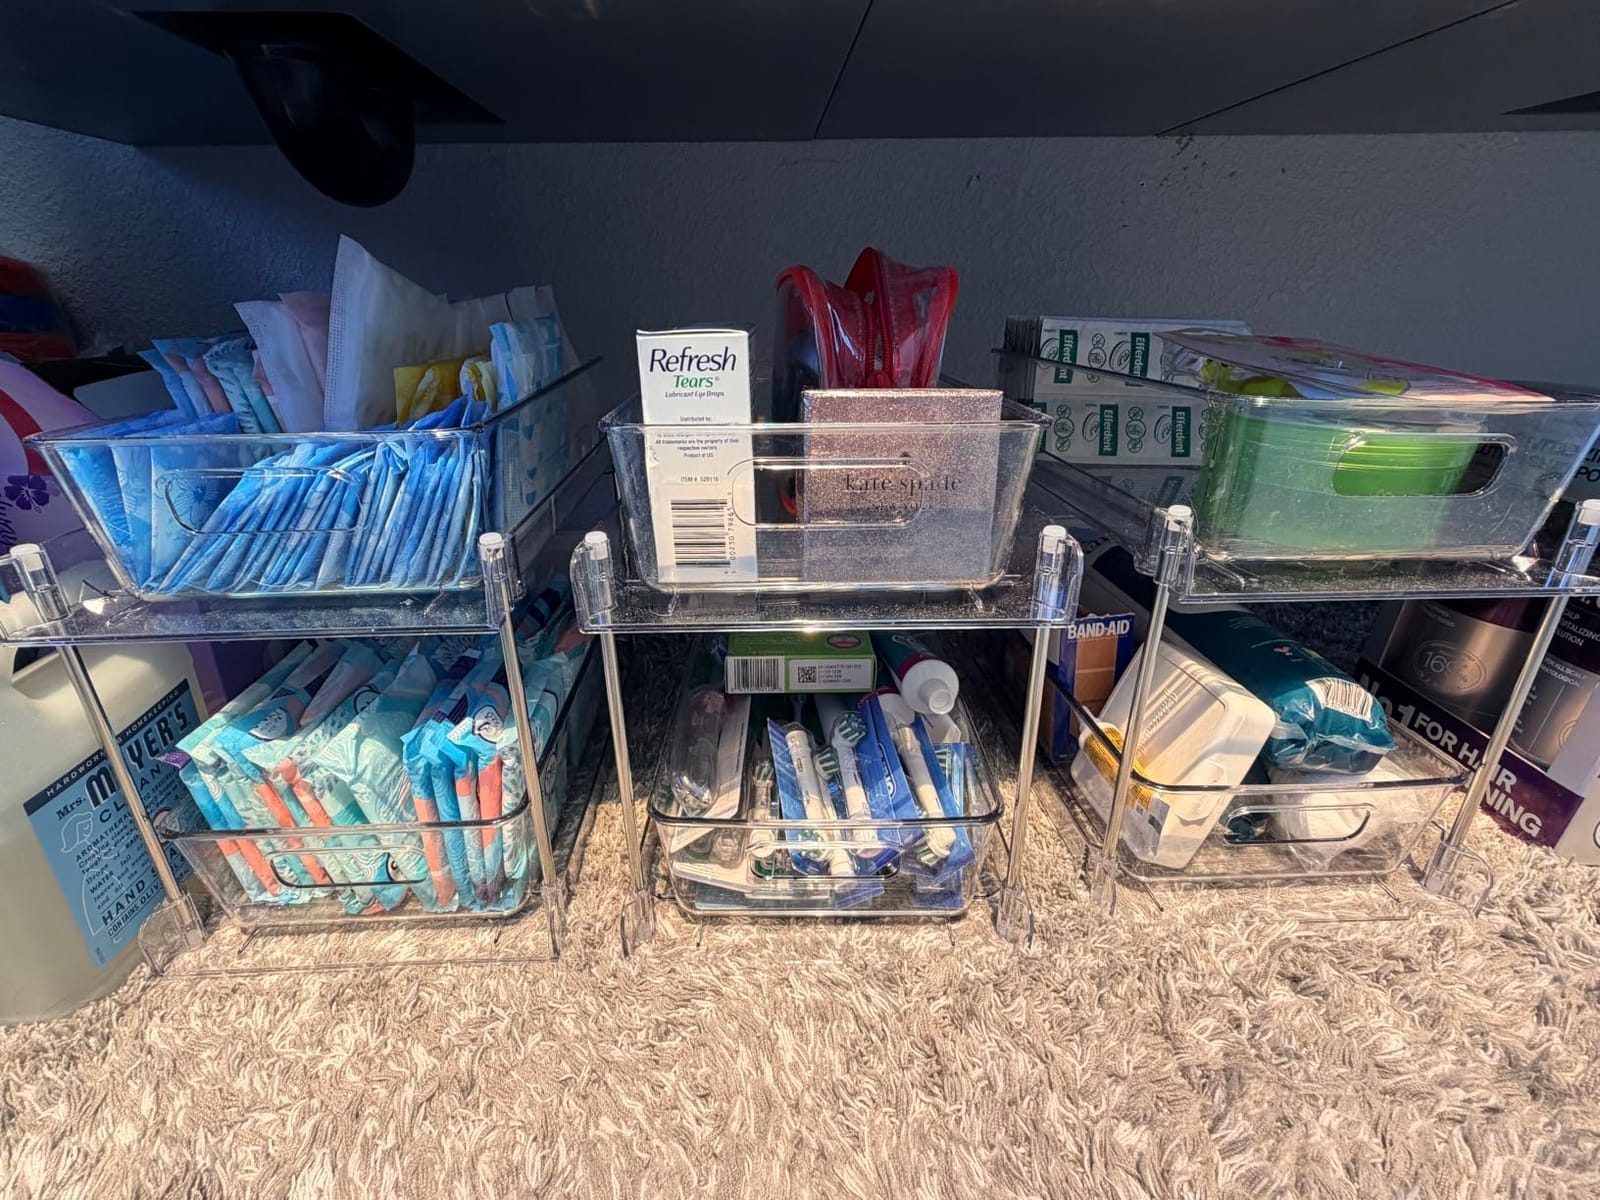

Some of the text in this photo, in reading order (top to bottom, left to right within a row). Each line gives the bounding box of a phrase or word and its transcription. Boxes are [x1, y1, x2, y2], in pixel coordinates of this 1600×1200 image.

[649, 346, 736, 373] Refresh
[1058, 334, 1074, 379] Efferdnt
[1134, 336, 1146, 377] Efferden
[664, 391, 725, 400] Lubricant Eye Drops
[1103, 408, 1114, 454] Efferdent
[1174, 410, 1185, 454] Efferdent
[846, 474, 892, 491] kate
[1067, 619, 1130, 640] BAND-AID
[56, 701, 189, 821] Mrs. MYER'S
[1414, 712, 1458, 753] FOR
[1457, 742, 1517, 794] HIR
[98, 763, 161, 824] CLAN
[86, 863, 109, 885] Drops
[90, 869, 114, 894] WATER
[102, 879, 146, 926] HAND
[107, 904, 139, 937] CONTAINS
[140, 881, 160, 905] OLIV
